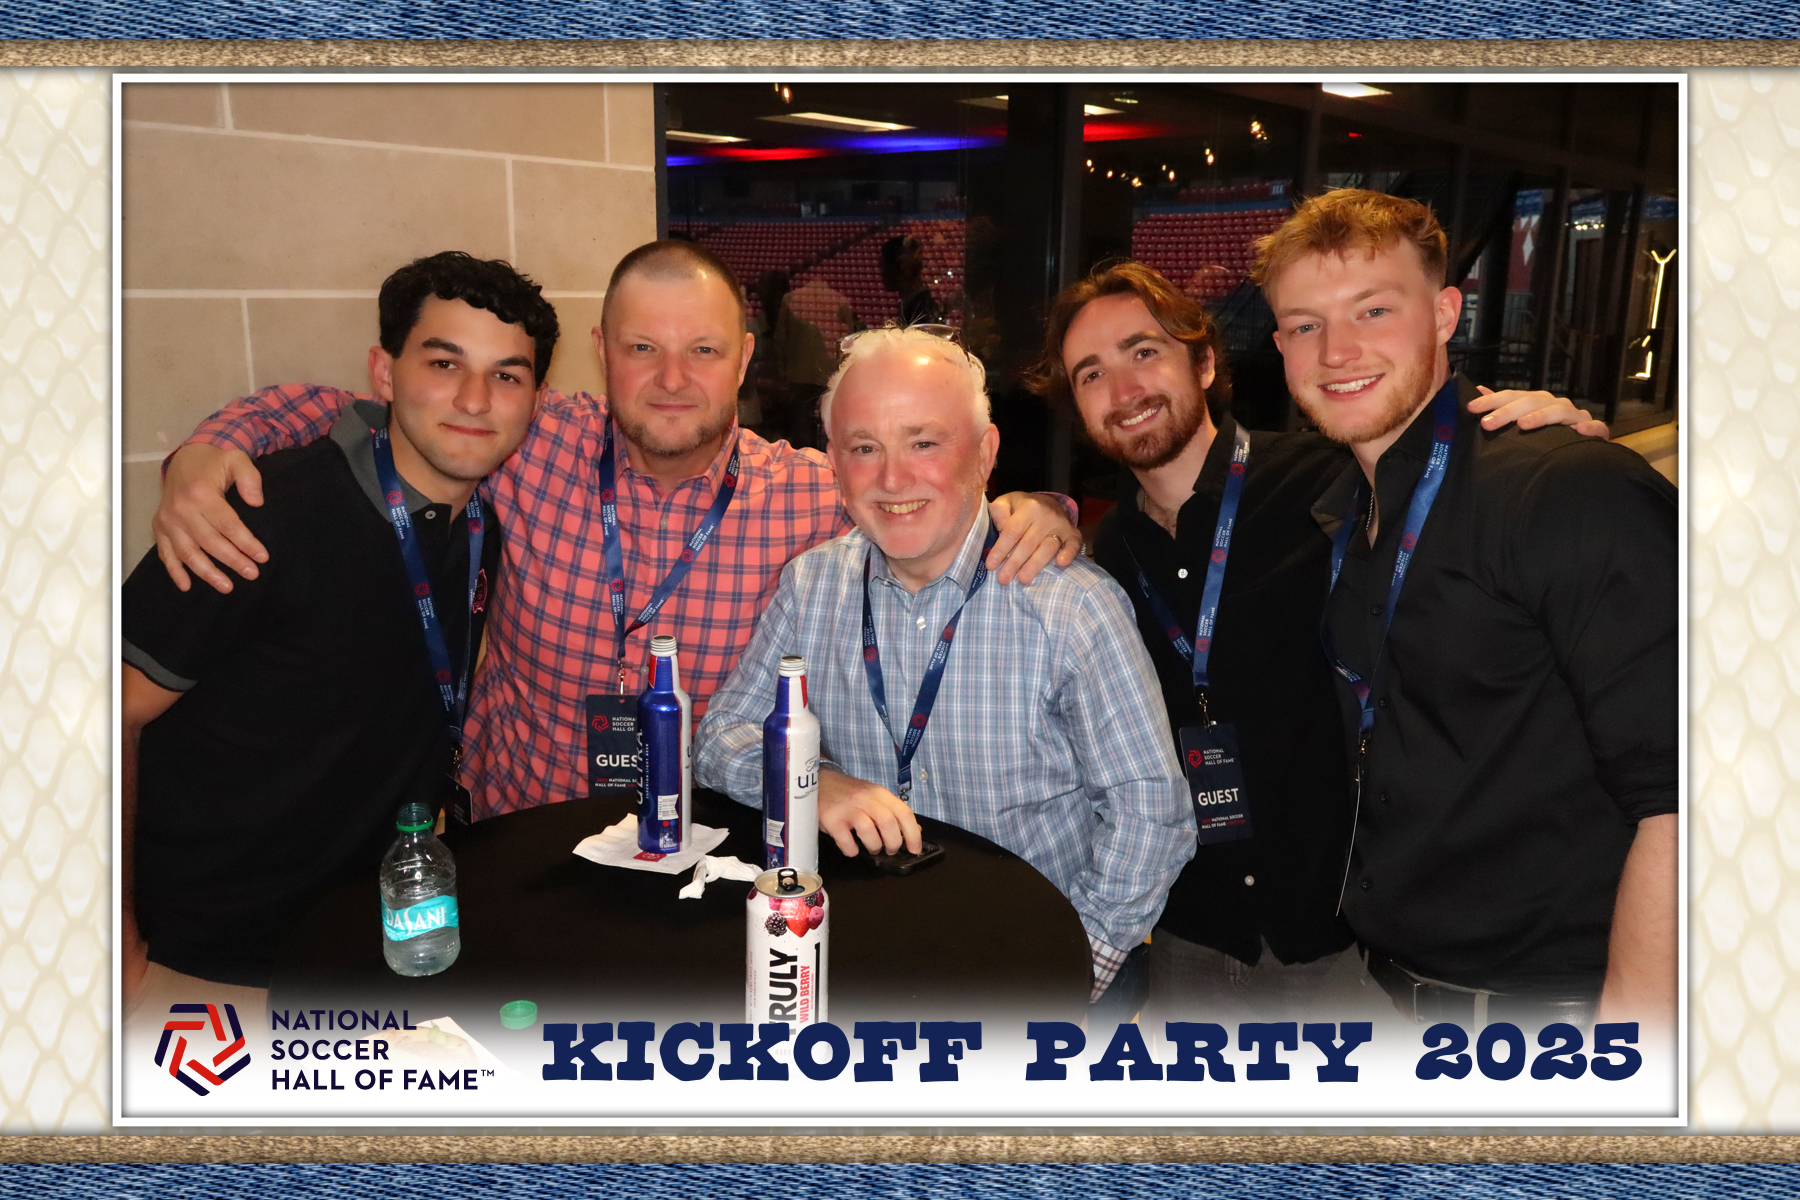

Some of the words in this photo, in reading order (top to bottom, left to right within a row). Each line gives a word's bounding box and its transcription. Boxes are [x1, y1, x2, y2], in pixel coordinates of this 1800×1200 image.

[1435, 443, 1444, 465] SOCCER
[1439, 444, 1449, 470] NATIONAL
[396, 507, 405, 526] SOCCER
[401, 506, 410, 528] NATIONAL
[689, 528, 702, 546] NATIONAL
[692, 533, 703, 549] SOCCER
[1215, 526, 1223, 547] NATIONAL
[595, 753, 638, 768] GUES
[1197, 787, 1239, 806] GUEST
[385, 907, 446, 936] DASANI
[800, 965, 810, 996] BERRY
[799, 998, 811, 1024] WILD
